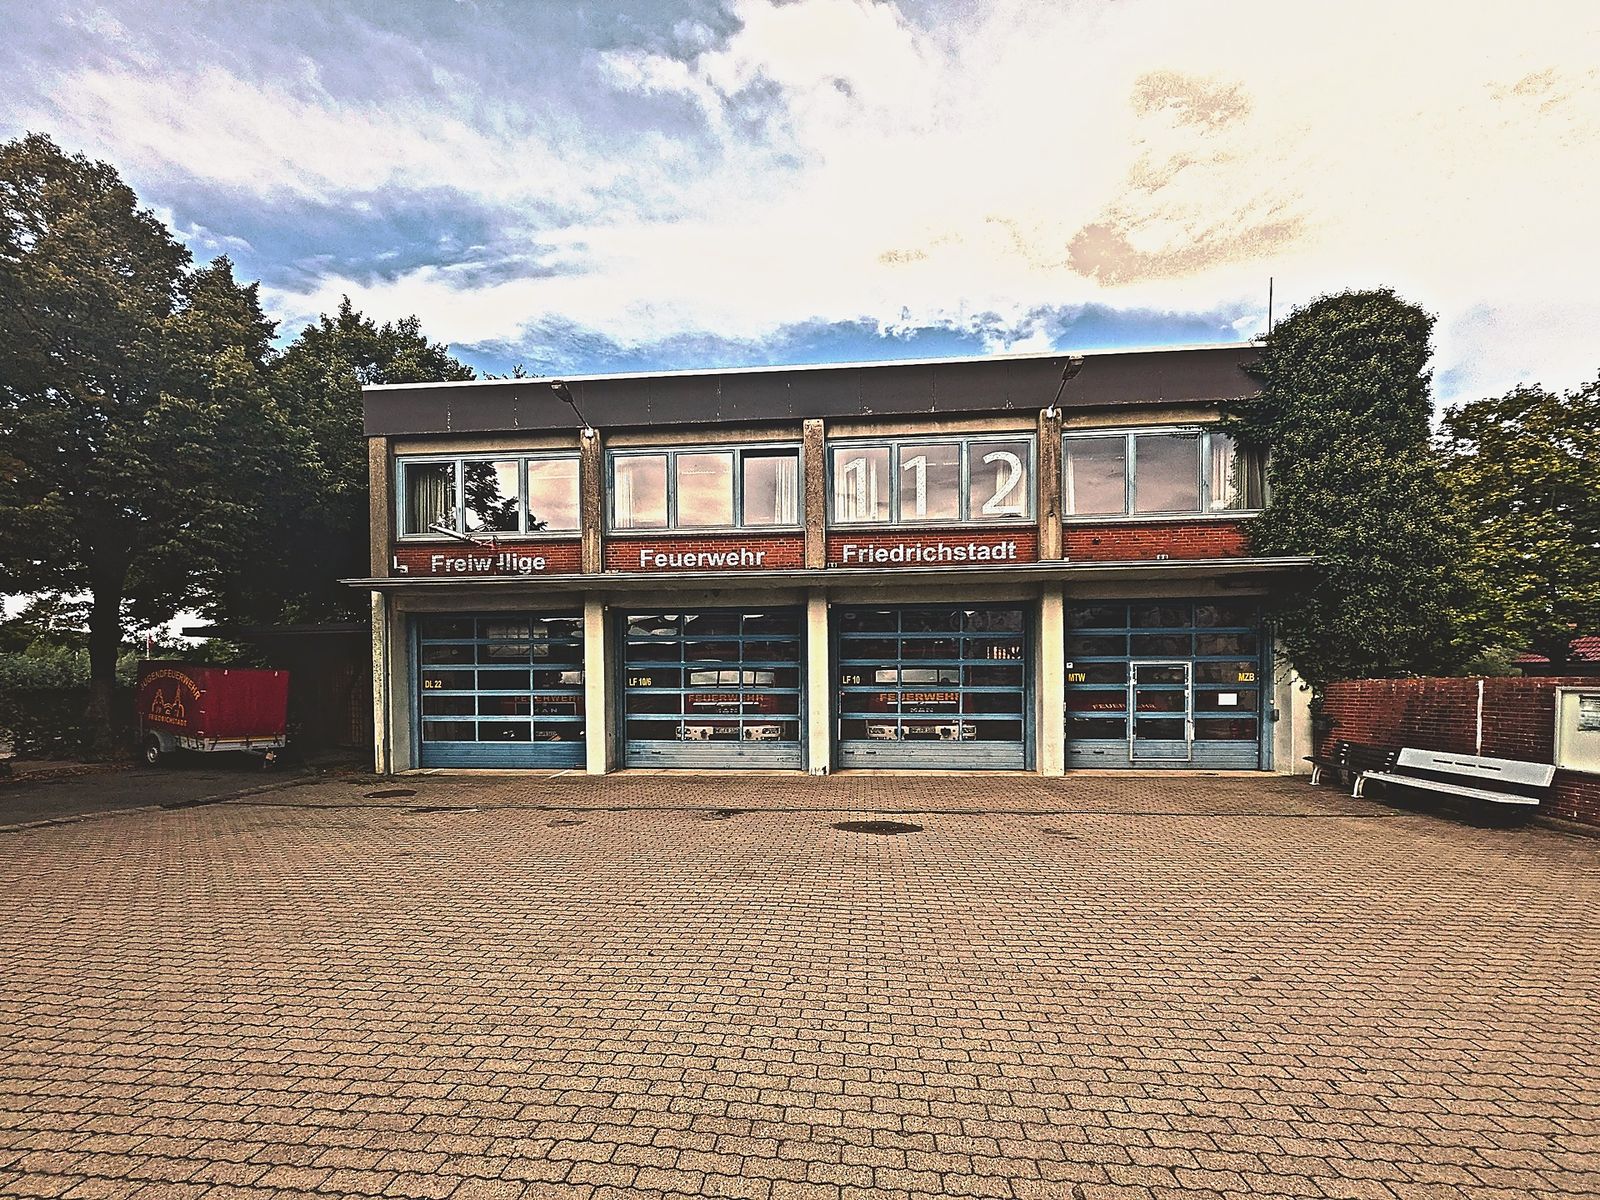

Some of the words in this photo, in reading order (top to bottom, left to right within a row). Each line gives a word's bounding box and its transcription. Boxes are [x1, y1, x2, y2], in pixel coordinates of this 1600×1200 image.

[431, 553, 546, 575] Freiwllige
[640, 547, 766, 568] Feuerwehr
[842, 541, 1017, 563] Friedrichstadt
[628, 677, 638, 686] LF
[842, 675, 852, 685] LF
[852, 675, 861, 685] 10
[1068, 672, 1086, 682] MTW
[1237, 672, 1255, 682] MZB
[140, 669, 201, 701] JUGENDFEUERWEHR
[424, 680, 434, 689] DL
[434, 680, 442, 689] 22
[688, 694, 764, 702] FEUERWHR
